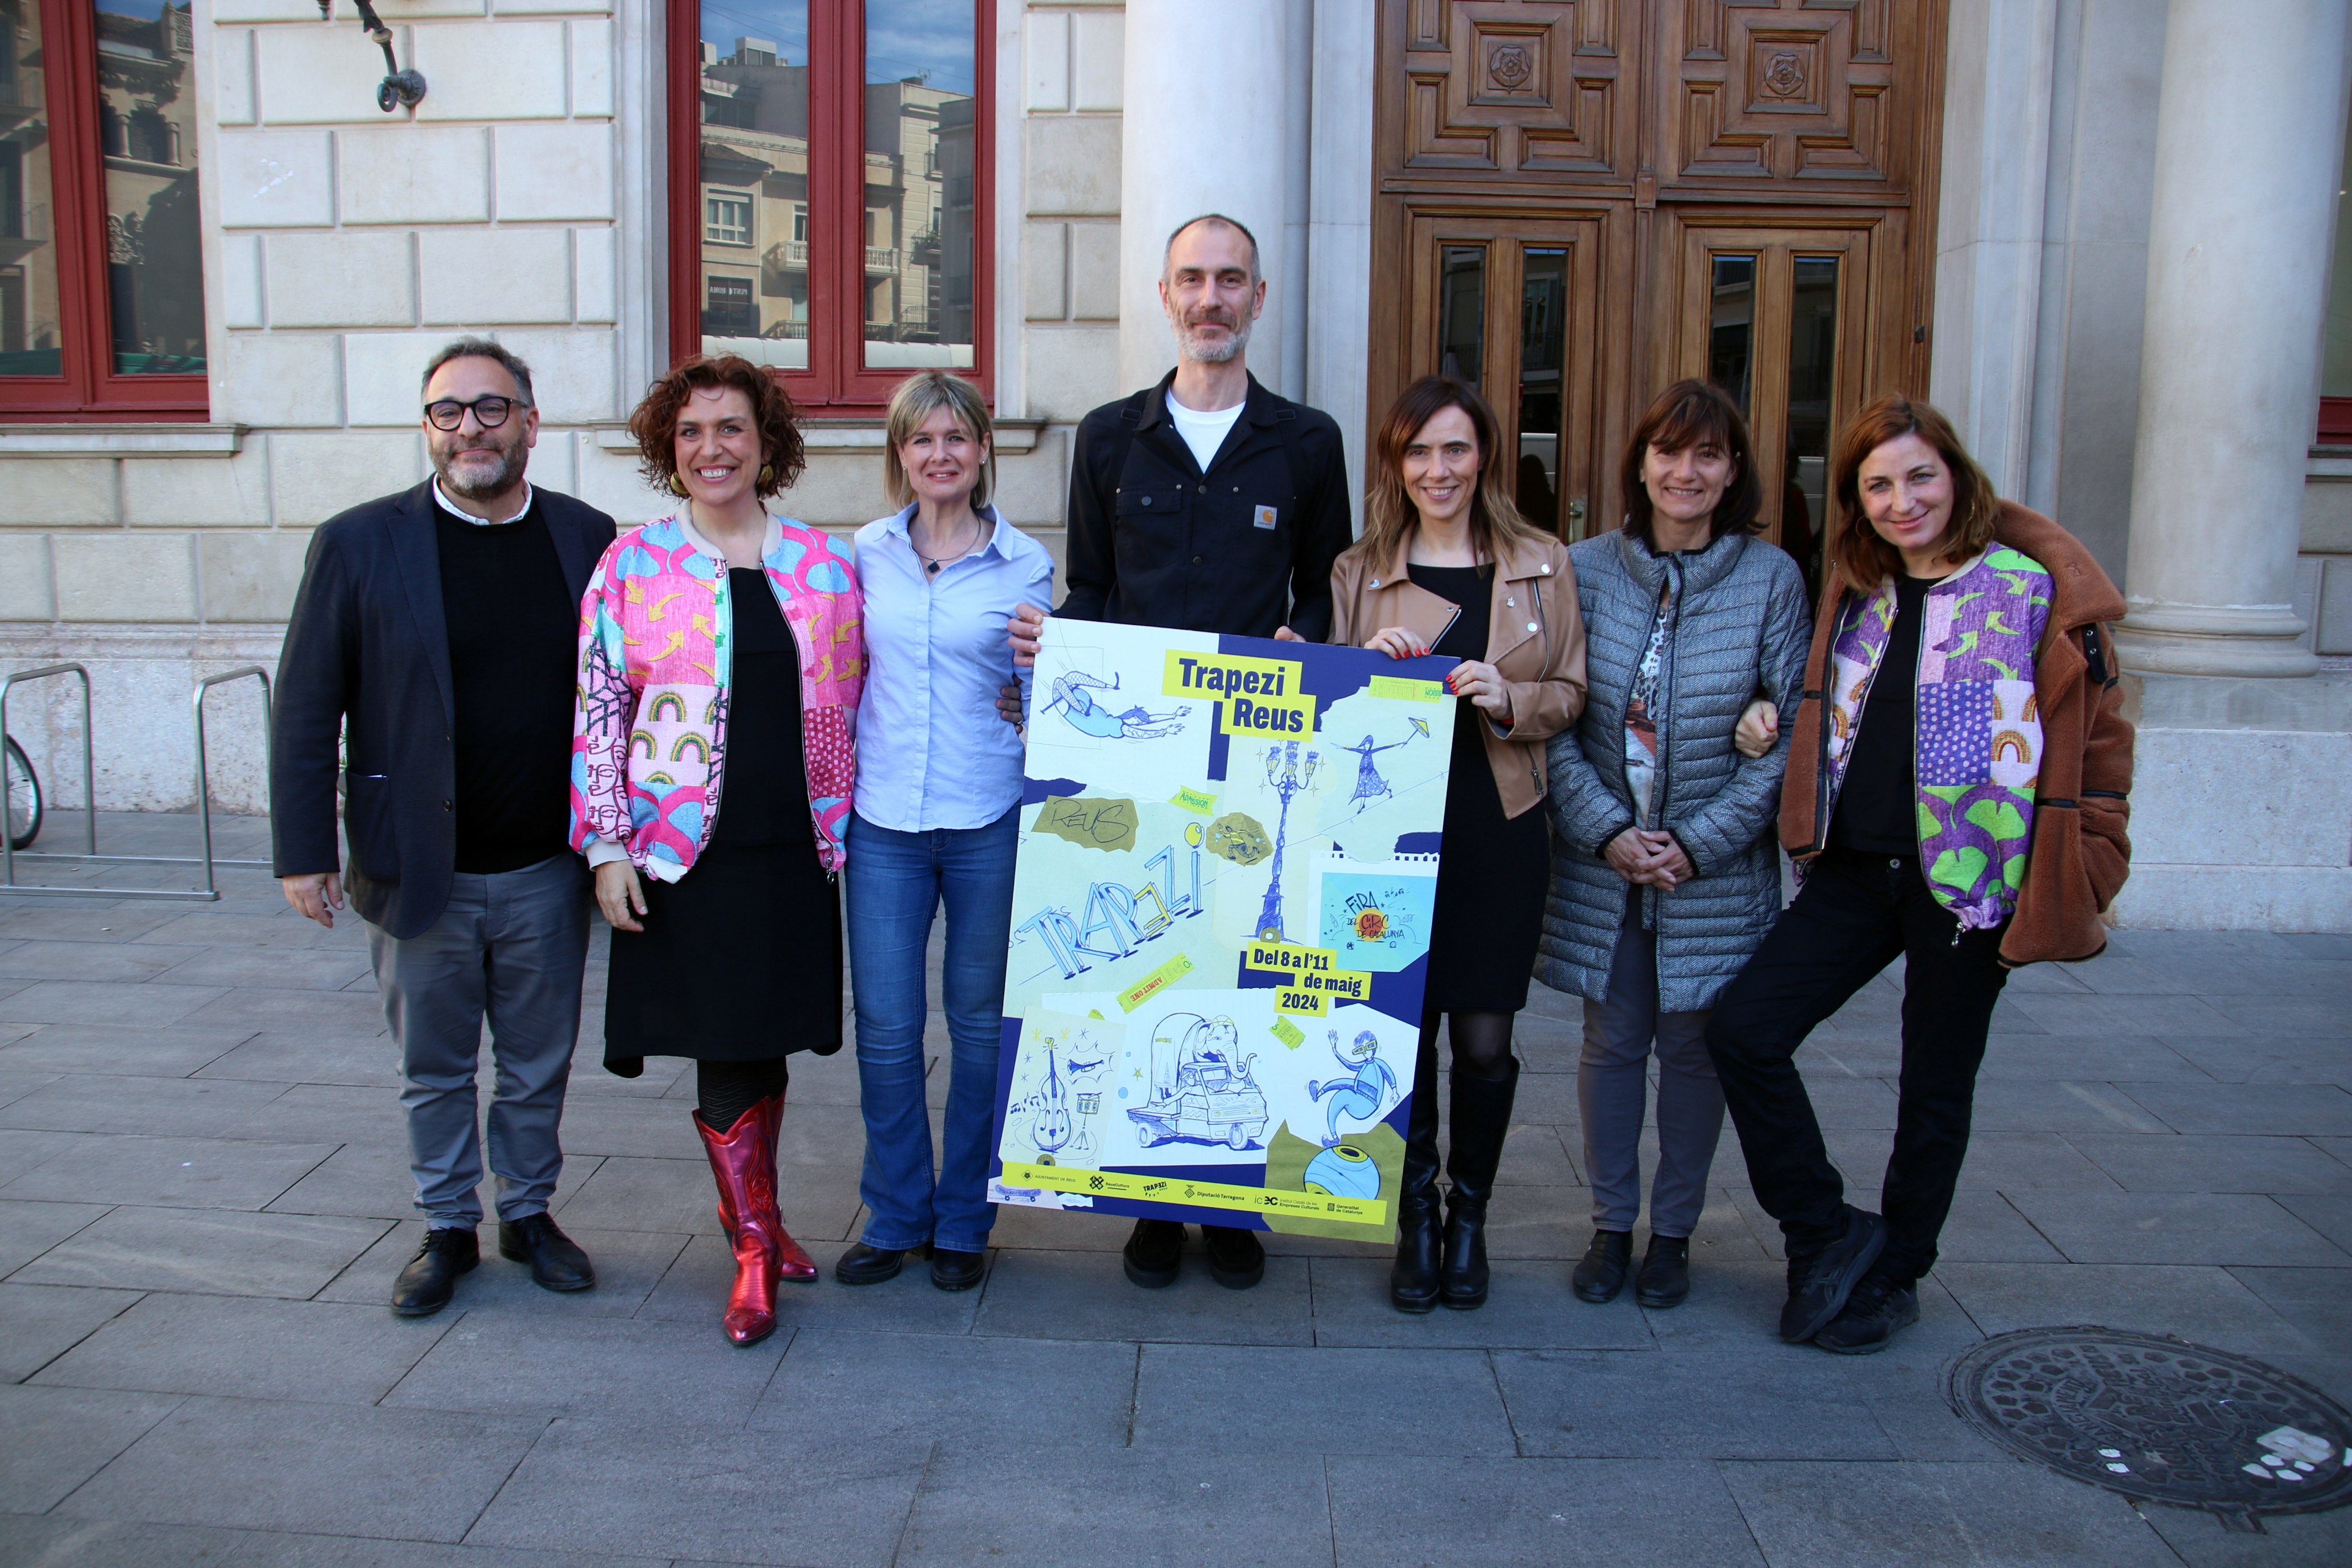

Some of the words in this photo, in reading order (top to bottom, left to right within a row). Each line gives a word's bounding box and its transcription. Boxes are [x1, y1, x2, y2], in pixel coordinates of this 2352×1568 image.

[1179, 658, 1286, 699] Trapezi
[1233, 698, 1304, 732] Reus
[1050, 799, 1129, 843] REUS
[1347, 917, 1359, 925] DEL
[1357, 929, 1366, 939] DE
[1369, 929, 1406, 939] CATALUNYA
[1254, 948, 1278, 965] Del
[1281, 951, 1290, 966] 8
[1292, 956, 1301, 968] a
[1144, 977, 1163, 993] ADMIT
[1304, 973, 1322, 989] de
[1325, 977, 1363, 997] maig
[1130, 992, 1144, 1001] ONE
[1282, 993, 1319, 1010] 2024
